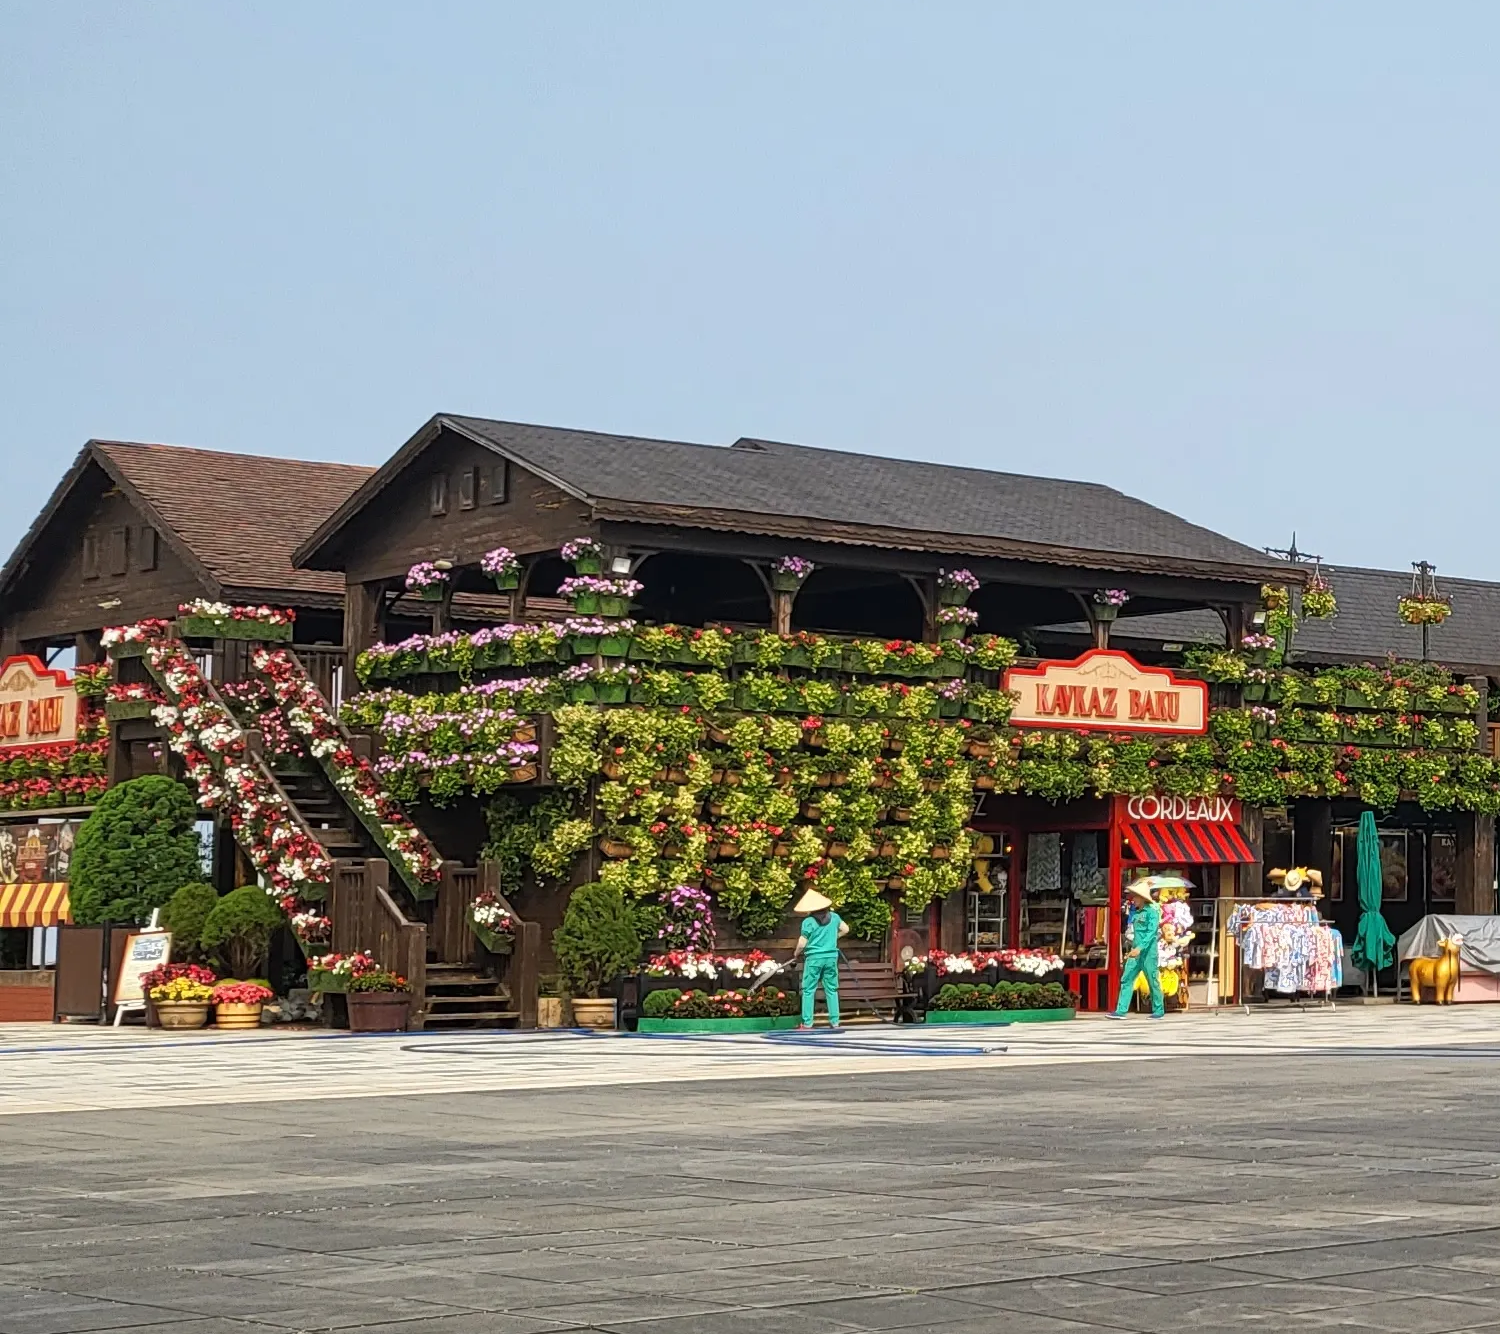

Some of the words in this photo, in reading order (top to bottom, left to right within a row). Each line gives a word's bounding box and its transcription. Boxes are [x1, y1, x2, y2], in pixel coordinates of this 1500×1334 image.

[1035, 683, 1118, 718] KAVKAZ
[1128, 689, 1180, 722] BAKU
[1127, 795, 1235, 822] CORDEAUX
